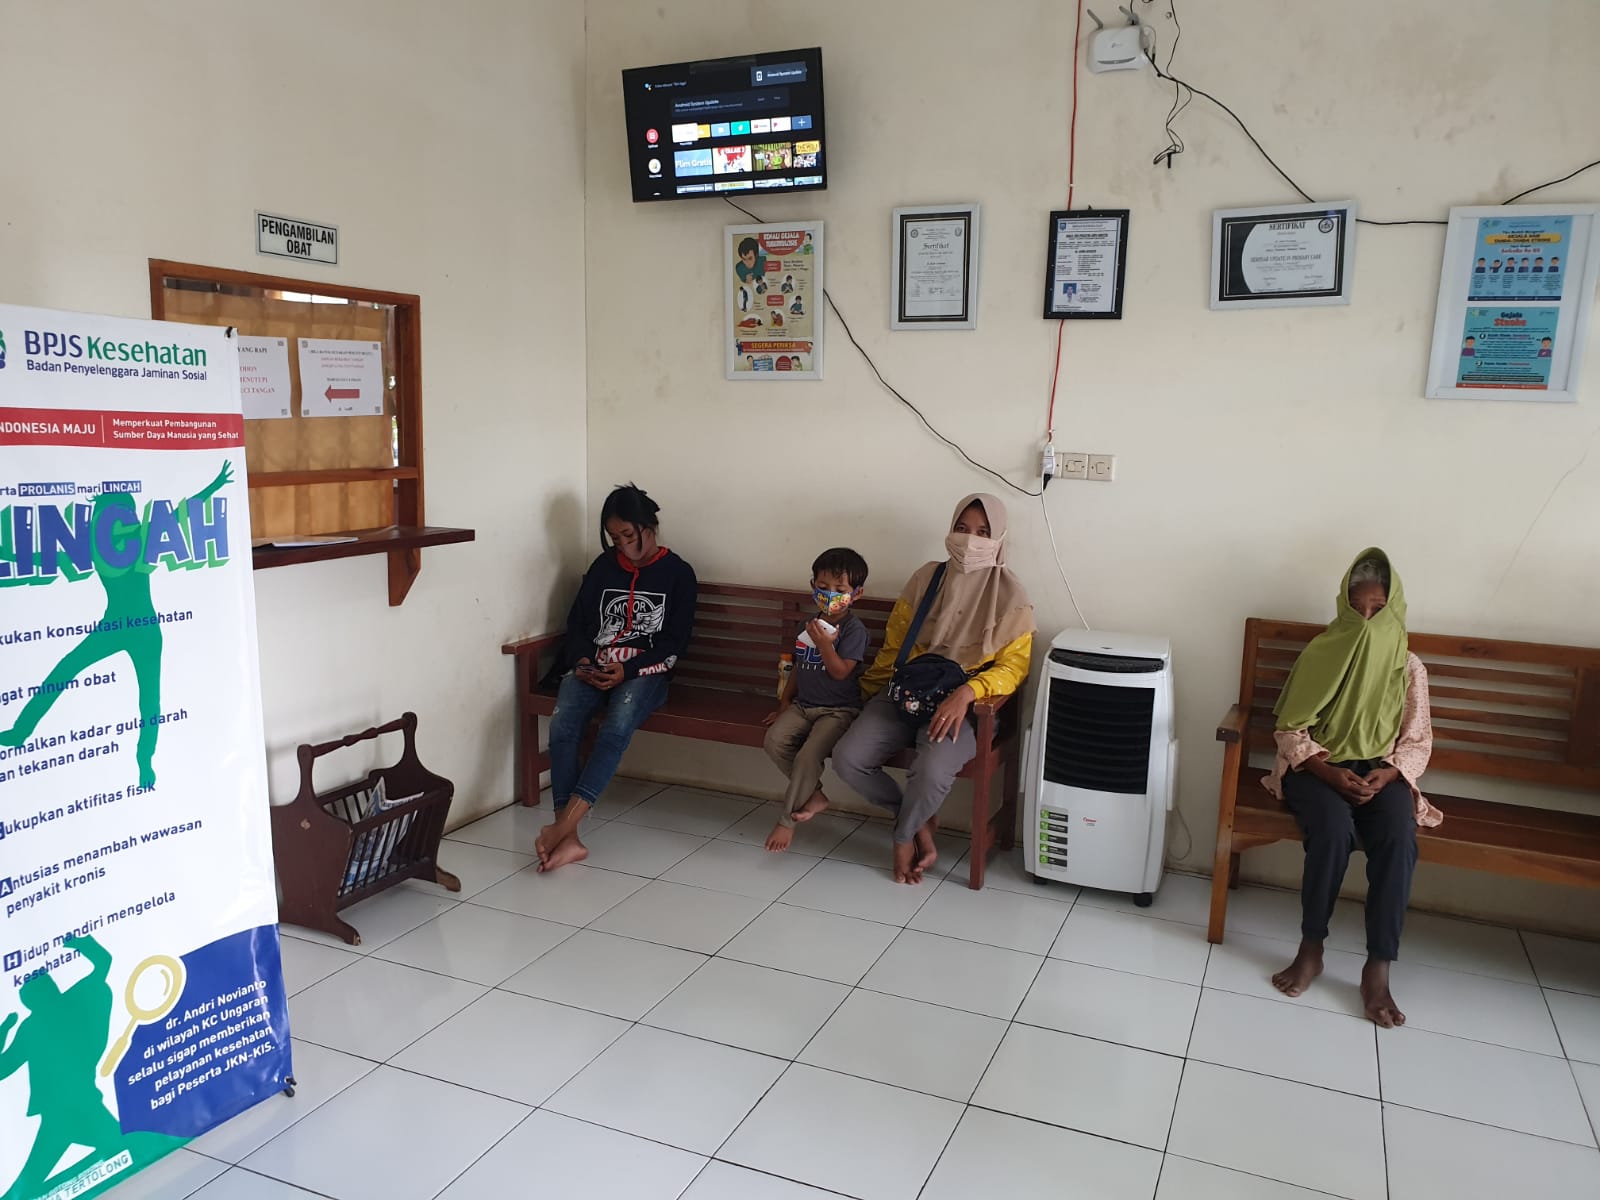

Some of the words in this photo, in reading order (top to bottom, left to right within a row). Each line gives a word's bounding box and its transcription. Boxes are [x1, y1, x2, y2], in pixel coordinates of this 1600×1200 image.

[261, 218, 335, 245] PENGAMBILAN
[286, 239, 312, 256] OBAT
[24, 330, 83, 358] BPJS
[86, 335, 207, 367] Kesehatan
[26, 359, 61, 373] Badan
[63, 362, 139, 378] Penyelenggara
[141, 367, 180, 379] Jaminan
[182, 369, 207, 381] Sosial
[62, 423, 96, 434] MAJU
[112, 418, 163, 429] Memperkuat
[164, 419, 217, 429] Pembangunan
[113, 430, 145, 440] Sumber
[146, 431, 166, 441] Daya
[167, 431, 197, 440] Manusia
[197, 432, 217, 441] yang
[217, 431, 239, 441] Sehat
[20, 484, 75, 496] PROLANIS
[77, 483, 101, 494] mari
[103, 481, 140, 493] LINCAH
[0, 497, 229, 583] INCAH
[46, 617, 123, 639] konsultasi
[126, 609, 193, 628] kesehatan
[614, 600, 646, 617] MOOR
[28, 678, 79, 697] minum
[84, 671, 117, 687] obat
[70, 724, 112, 742] kadar
[116, 716, 146, 735] gula
[149, 708, 188, 726] darah
[19, 752, 75, 776] tekanan
[78, 741, 119, 760] darah
[67, 790, 123, 815] aktifitas
[126, 782, 156, 798] fisik
[0, 863, 60, 897] Antusias
[63, 836, 137, 870] menambah
[140, 819, 203, 844] wawasan
[6, 884, 61, 918] penyakit
[64, 866, 107, 891] kronis
[4, 942, 50, 972] Hidup
[53, 915, 104, 949] mandiri
[106, 890, 176, 925] mengelola
[13, 948, 81, 988] kesehatan
[165, 1017, 182, 1030] dr.
[184, 999, 215, 1022] Andri
[217, 980, 267, 1007] Novianto
[143, 1046, 155, 1059] di
[156, 1025, 200, 1051] wilayah
[202, 1014, 218, 1030] KC
[220, 994, 269, 1021] Ungaran
[128, 1061, 165, 1086] selalu
[167, 1045, 197, 1066] sigap
[199, 1010, 271, 1049] memberikan
[154, 1053, 212, 1092] pelayanan
[214, 1026, 273, 1059] kesehatan
[150, 1089, 176, 1110] bagi
[177, 1066, 222, 1096] Peserta
[224, 1040, 276, 1071] JKN-KIS.
[65, 1154, 129, 1198] TERTOLONG
